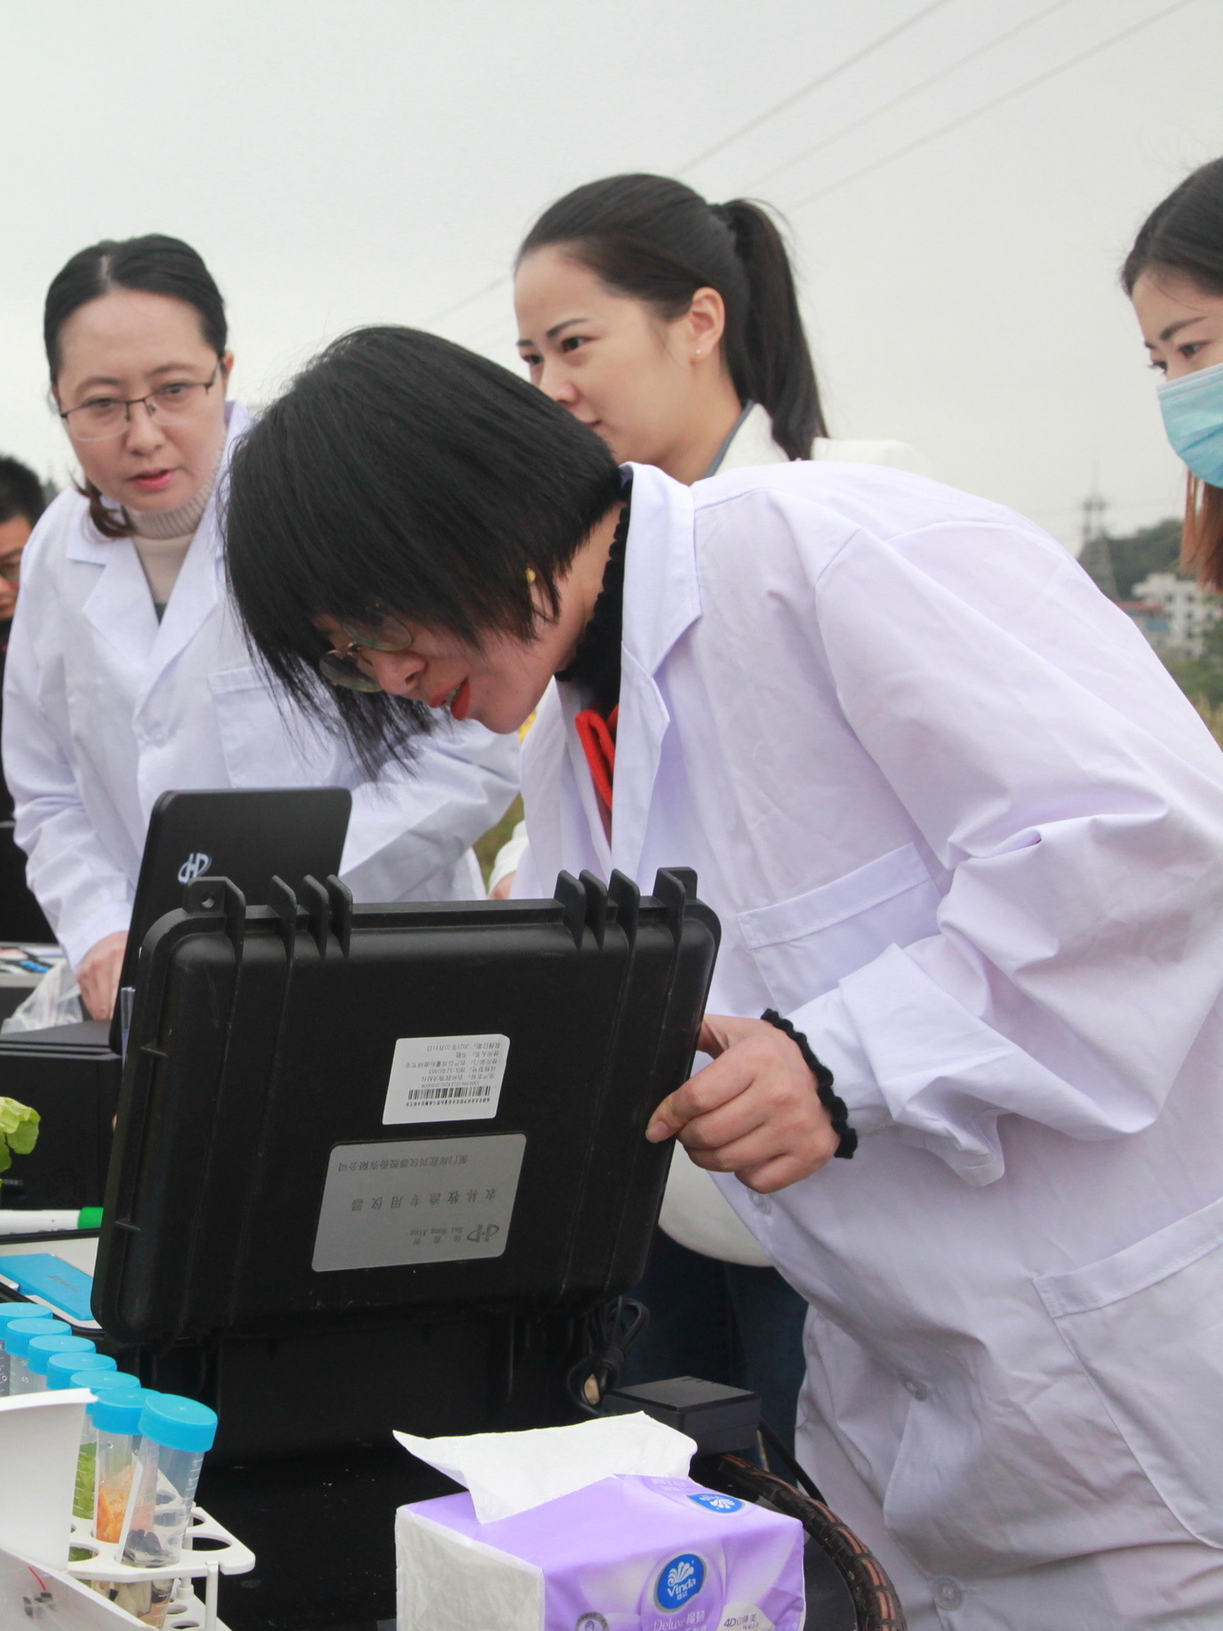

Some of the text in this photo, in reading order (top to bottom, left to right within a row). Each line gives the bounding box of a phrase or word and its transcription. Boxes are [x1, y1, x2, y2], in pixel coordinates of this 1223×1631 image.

[350, 1188, 498, 1213] 农林牧渔专用仪器
[667, 1577, 696, 1598] Vinda
